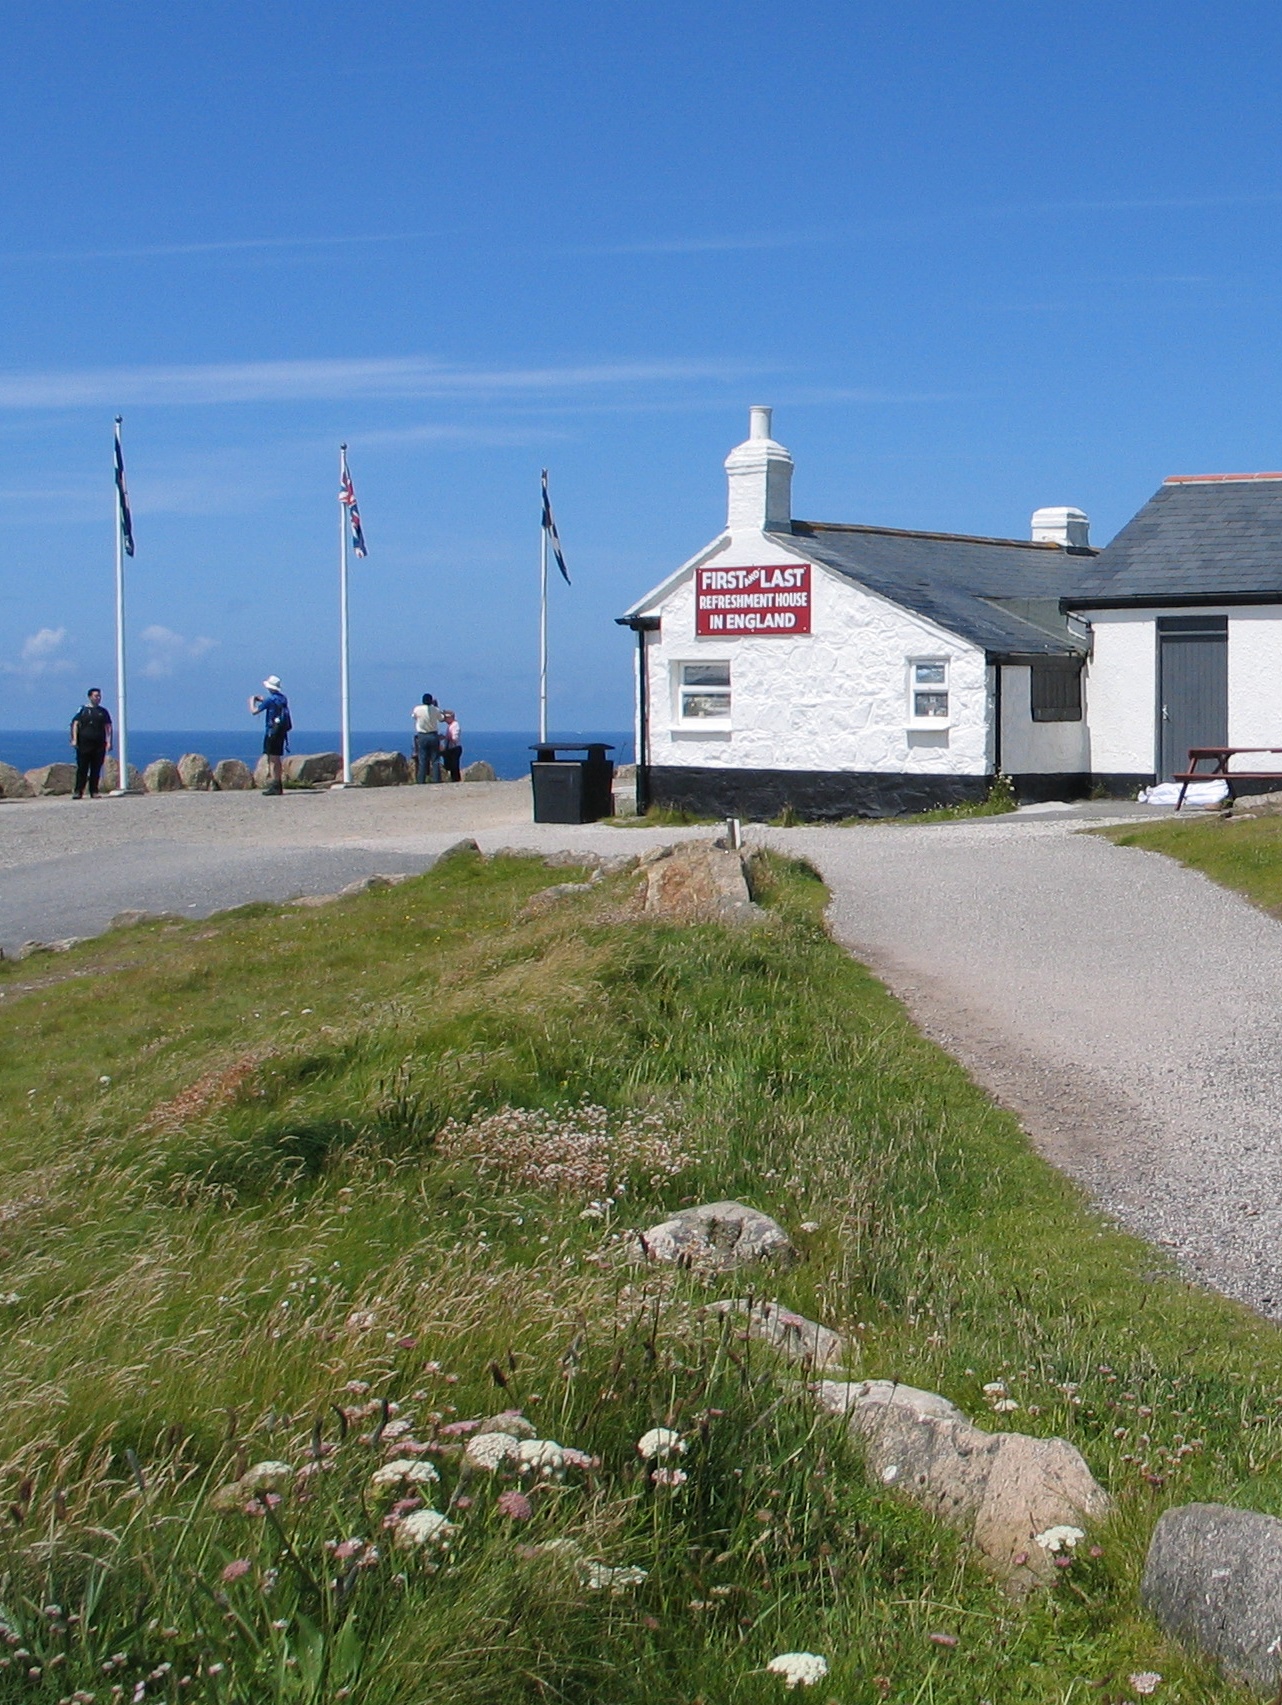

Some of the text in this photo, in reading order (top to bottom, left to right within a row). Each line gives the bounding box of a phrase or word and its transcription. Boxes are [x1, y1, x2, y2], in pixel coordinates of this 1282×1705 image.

[702, 571, 746, 589] FIRST
[760, 569, 804, 588] LAST
[700, 592, 807, 609] REFRESHMENT HOUSE
[709, 613, 795, 629] IN ENGLAND
